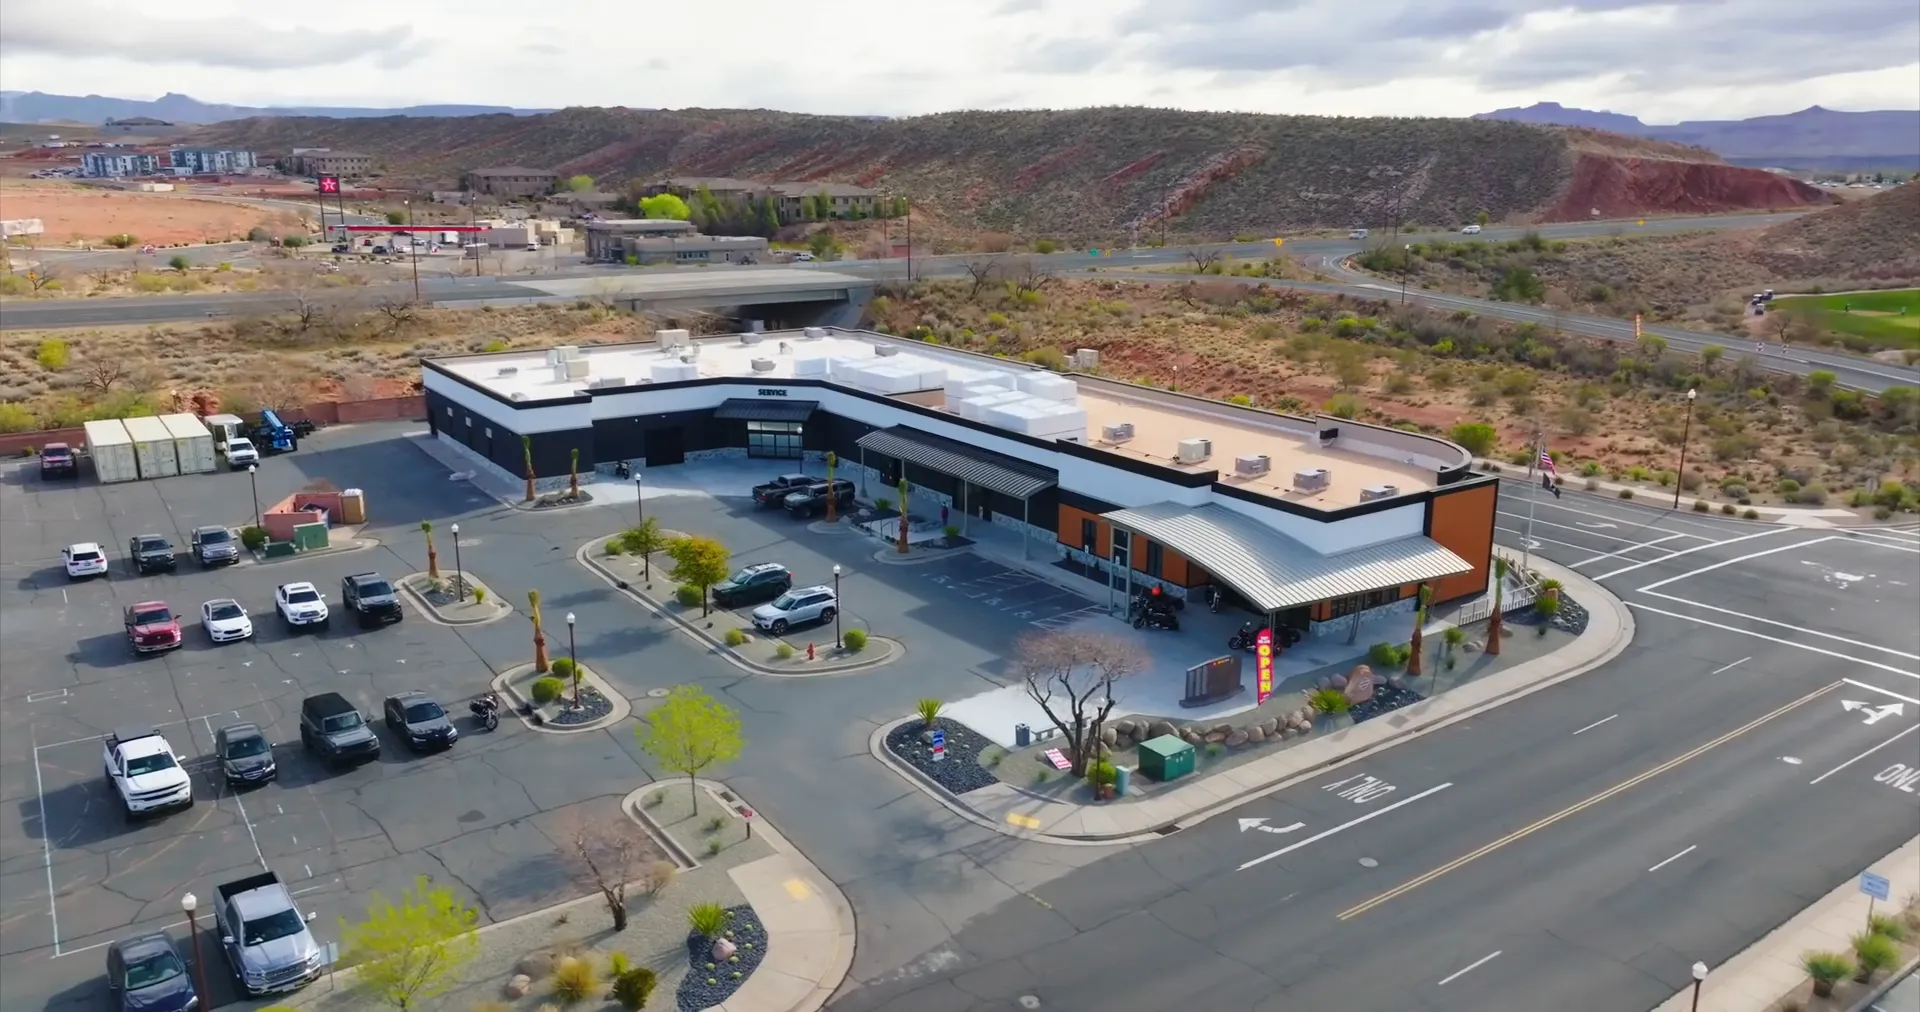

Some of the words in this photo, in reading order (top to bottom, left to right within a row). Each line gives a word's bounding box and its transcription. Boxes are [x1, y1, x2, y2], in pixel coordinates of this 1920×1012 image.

[757, 388, 788, 397] SERVICE
[1258, 644, 1271, 693] OPEN
[1321, 773, 1397, 803] ONLY
[1873, 763, 1920, 796] ONL
